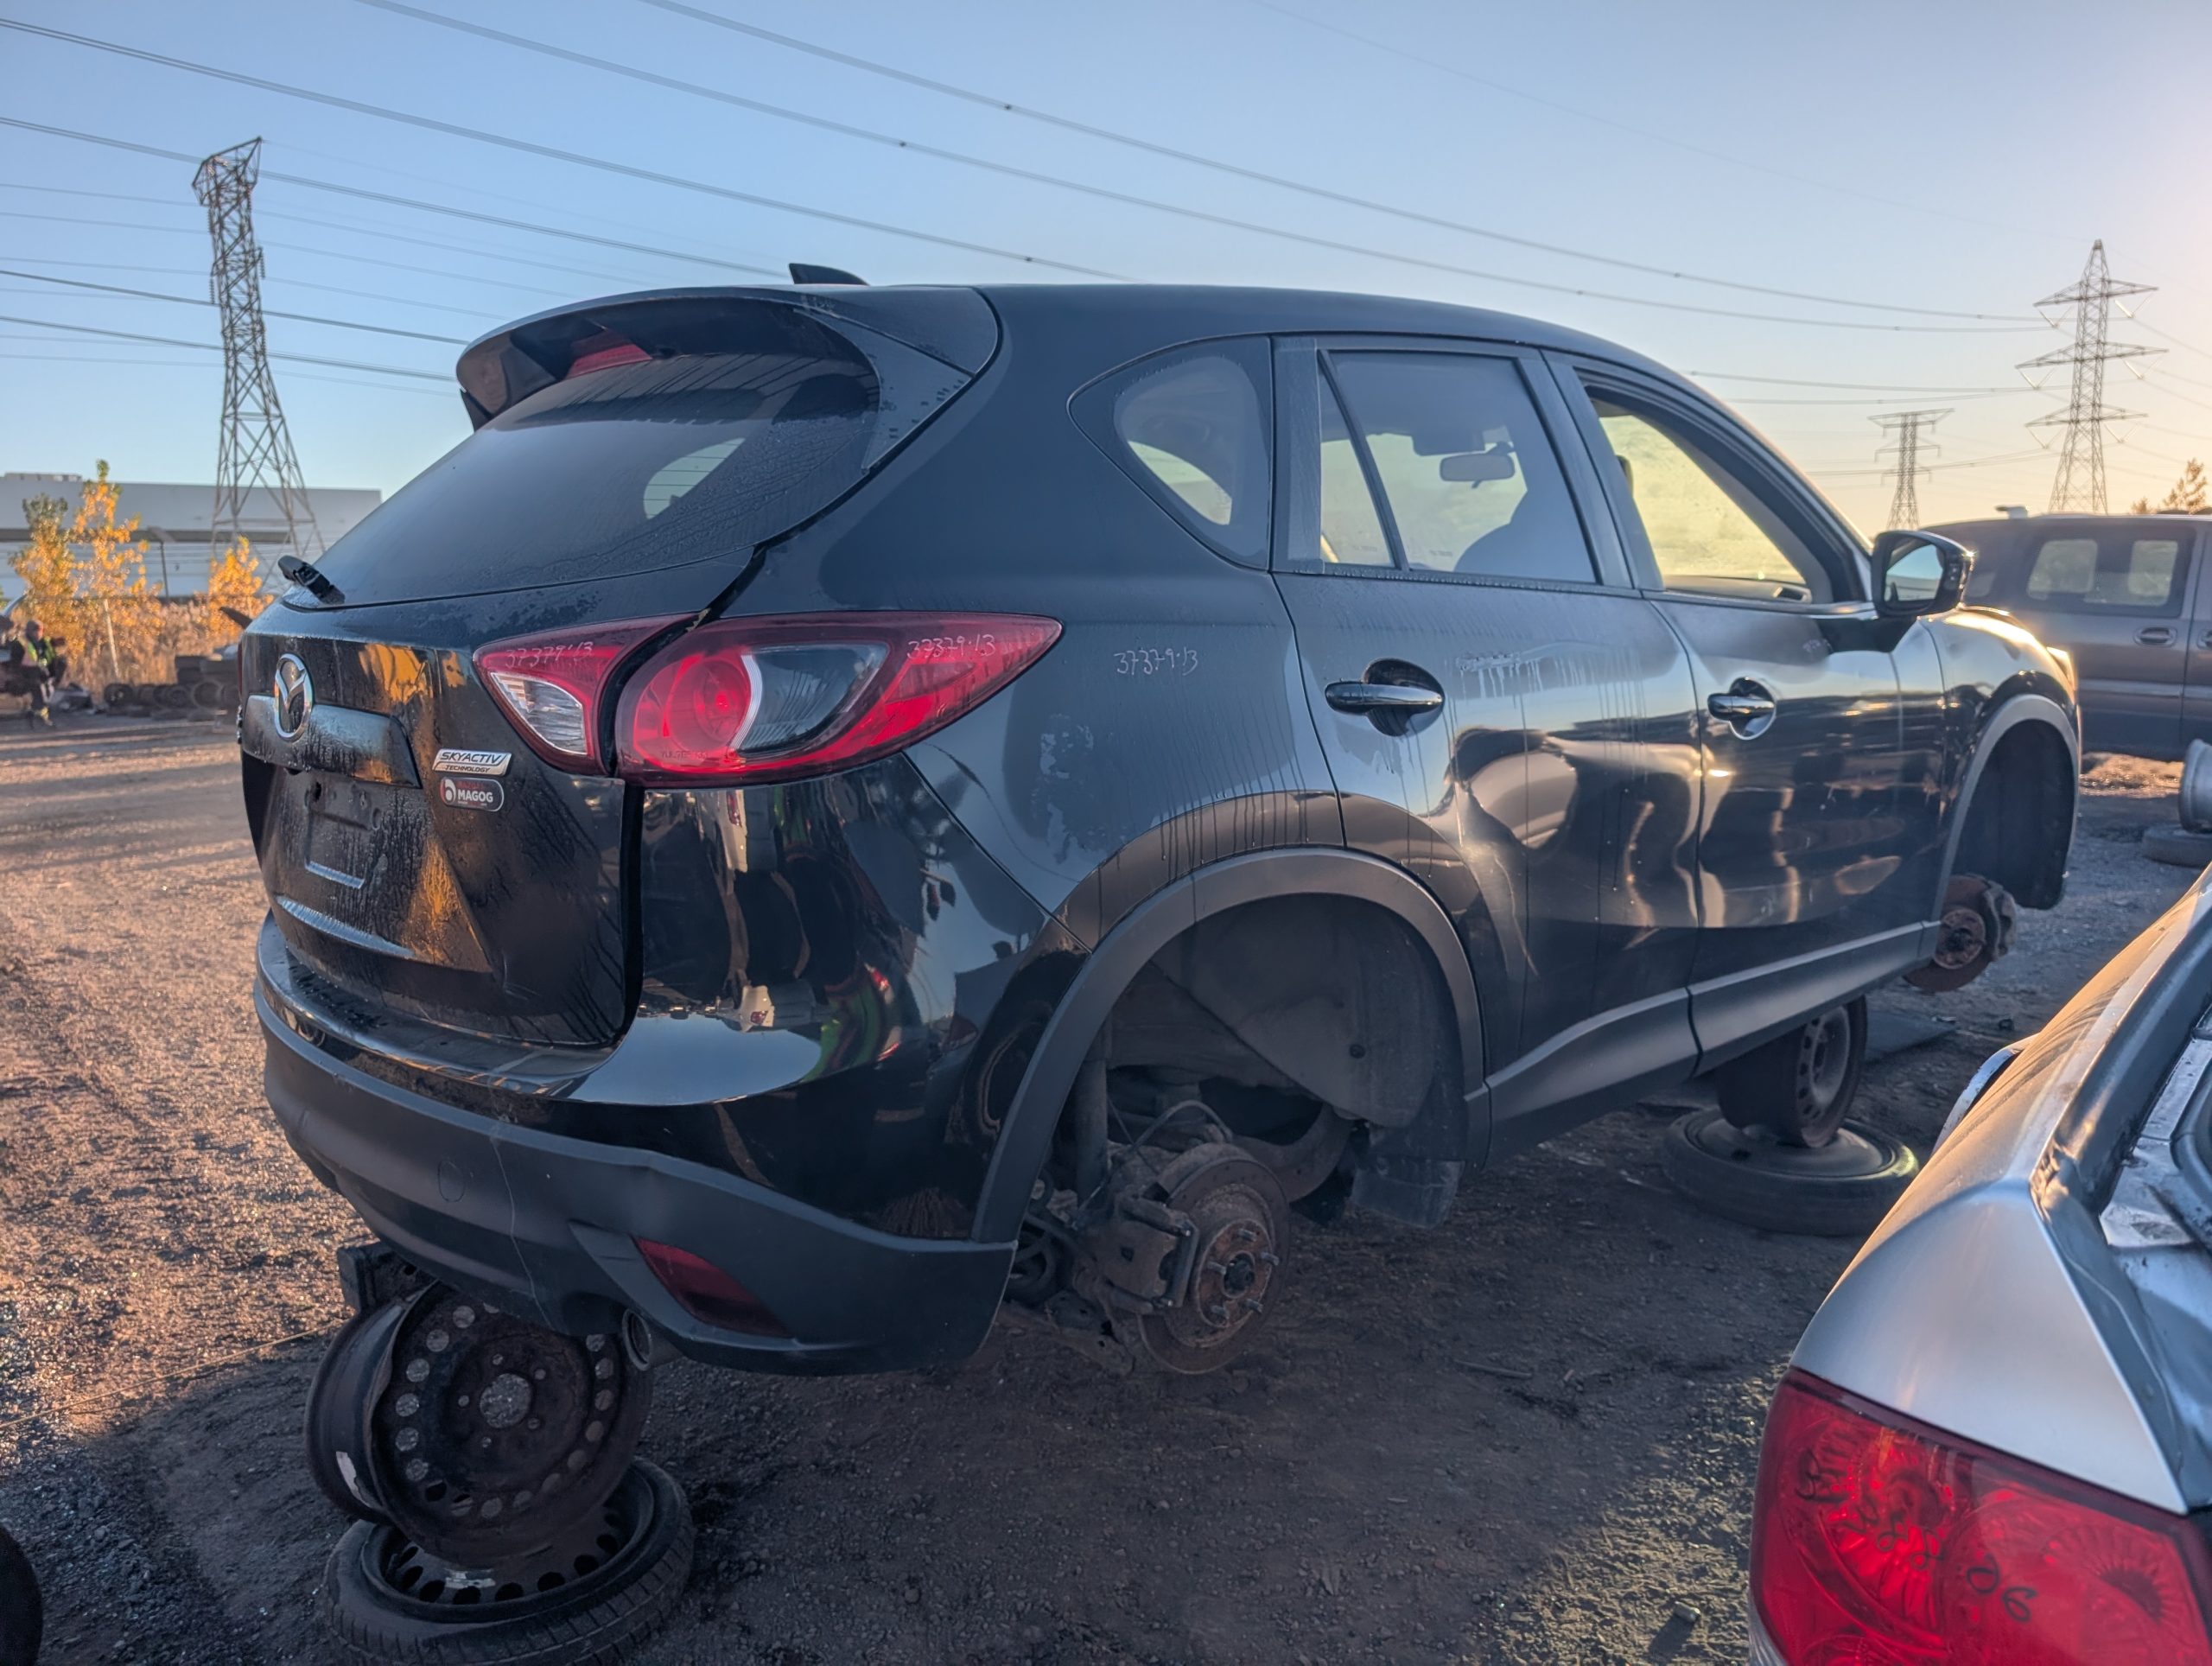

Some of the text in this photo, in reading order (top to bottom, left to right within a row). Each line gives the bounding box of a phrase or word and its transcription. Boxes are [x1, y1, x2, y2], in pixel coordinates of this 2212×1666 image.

[440, 751, 502, 764] SKYACTIV
[445, 764, 491, 773] TECHNOLOGY
[457, 788, 493, 803] MAGOG
